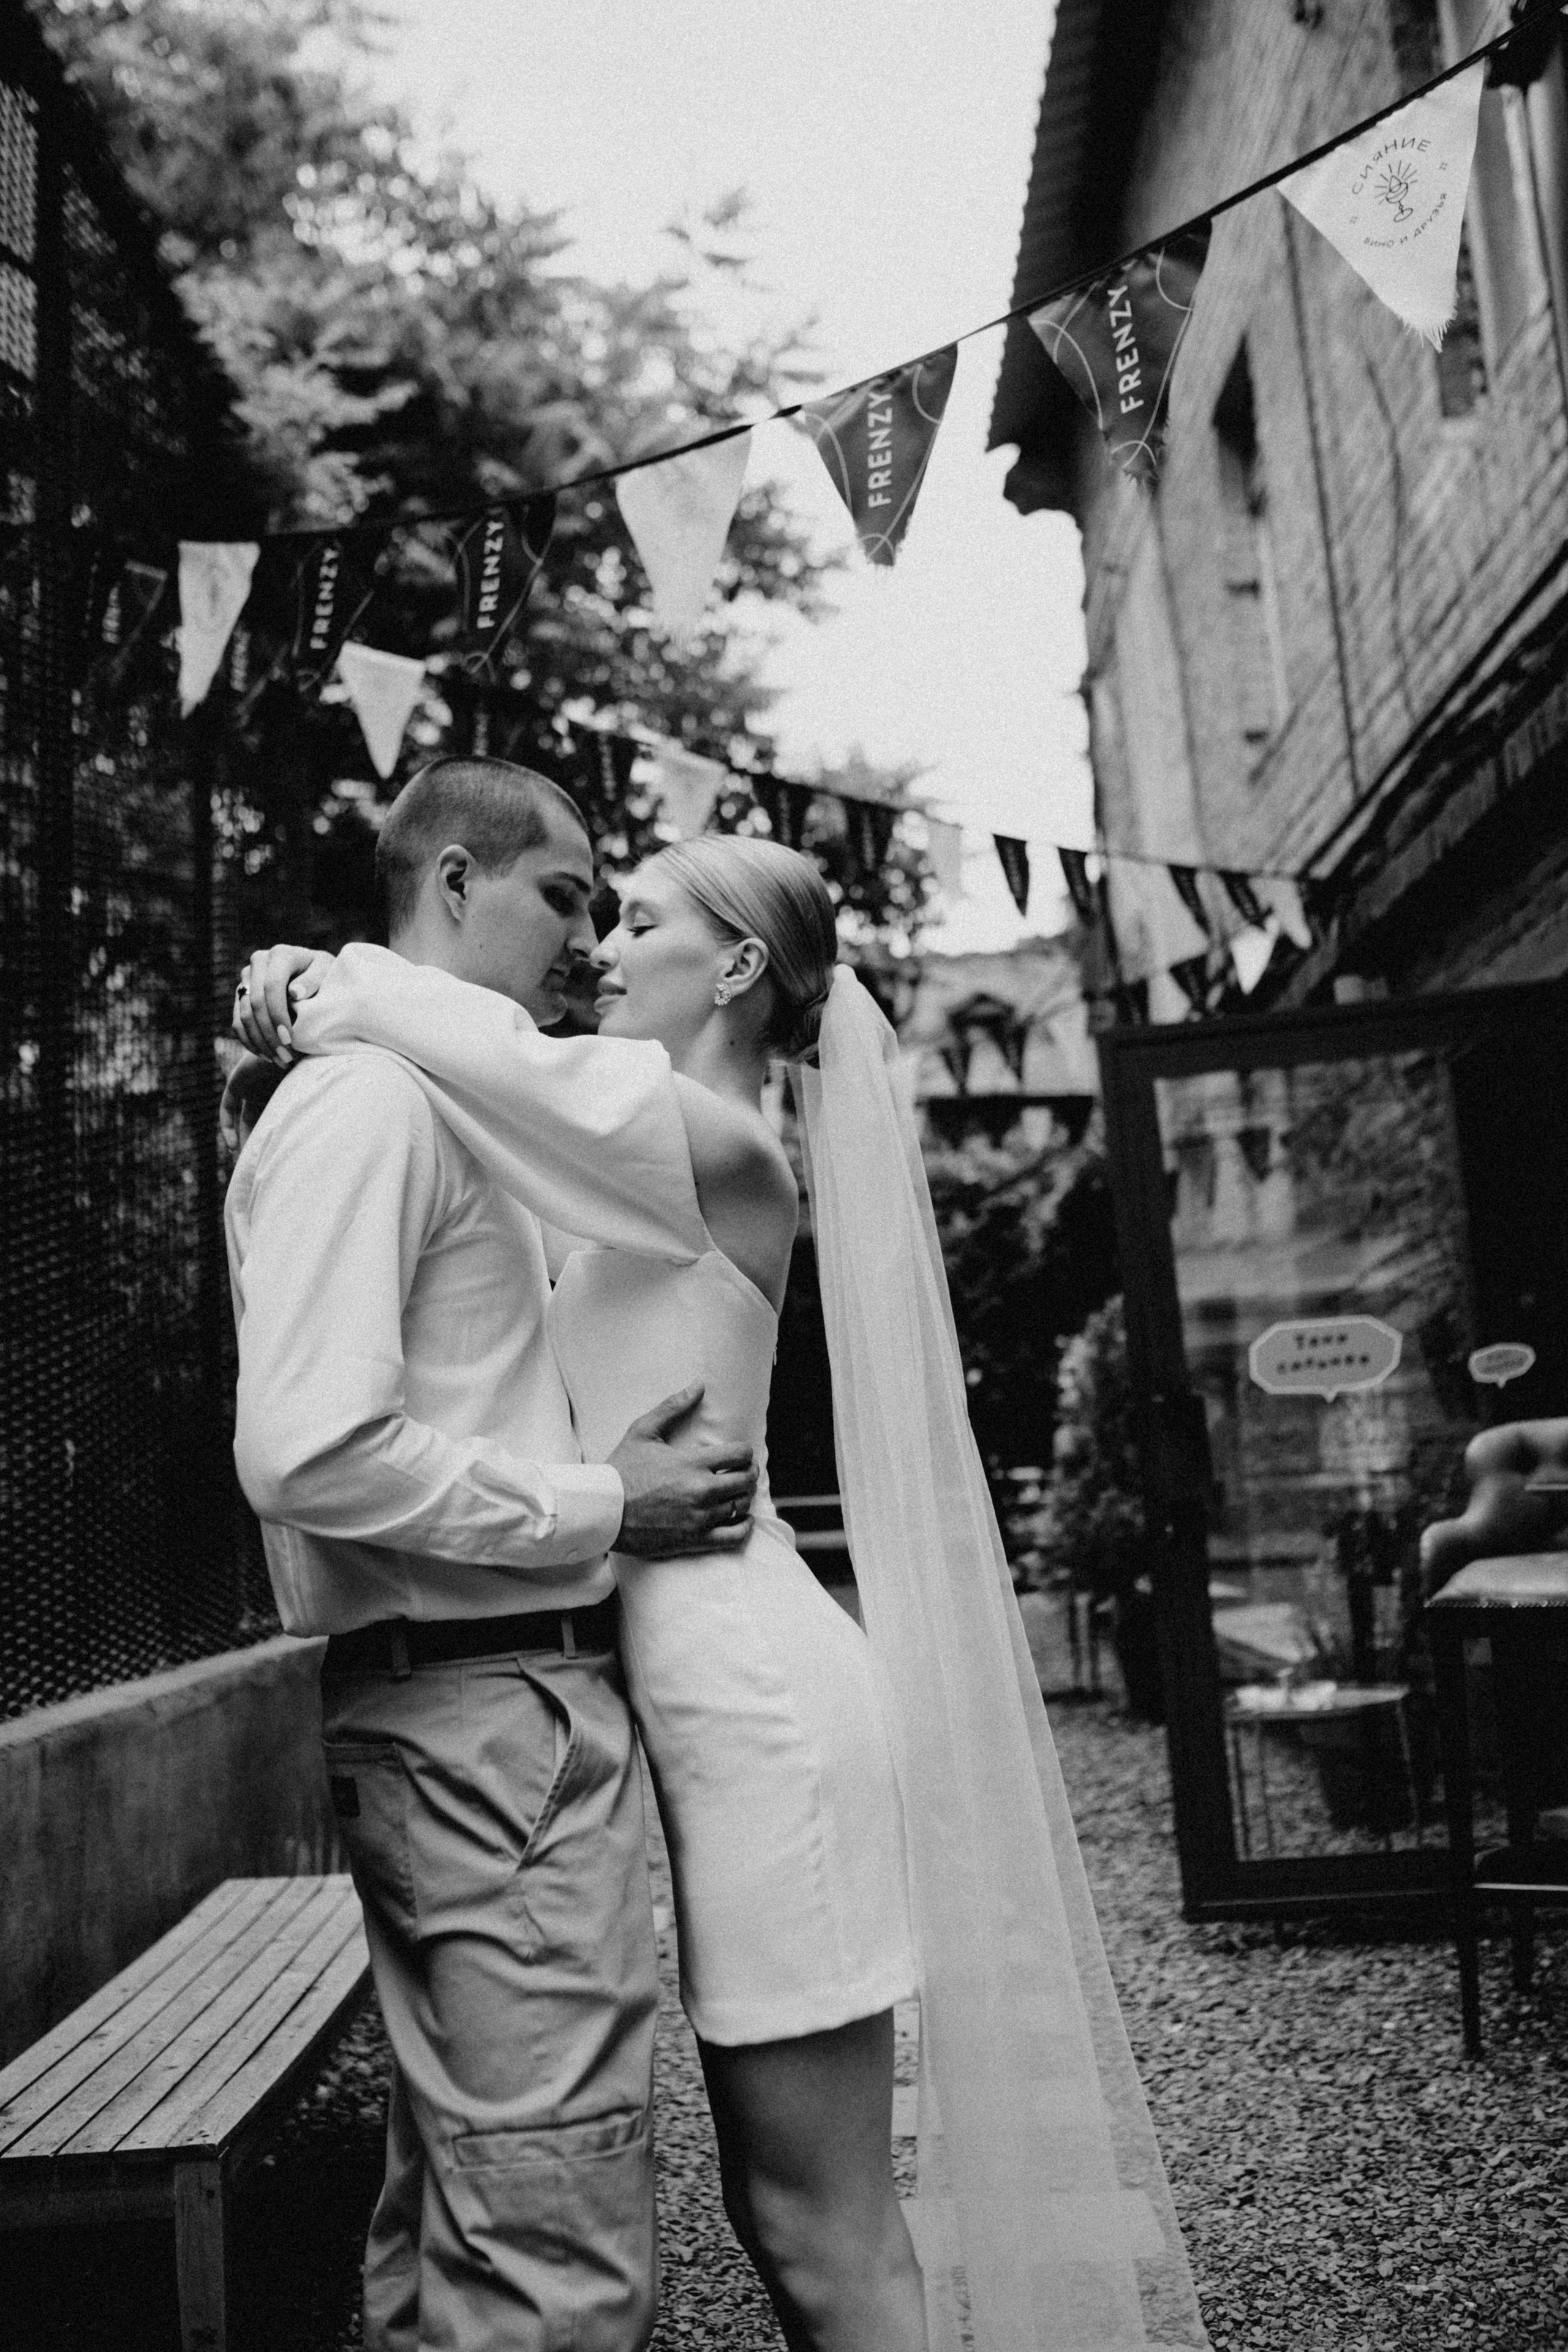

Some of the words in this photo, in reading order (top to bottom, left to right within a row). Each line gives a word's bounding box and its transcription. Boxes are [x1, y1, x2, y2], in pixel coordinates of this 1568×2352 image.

[1352, 137, 1431, 195] СИЯНИЕ
[1414, 193, 1447, 238] ДРУЗЬЯ
[1107, 285, 1145, 414] FRENZY
[867, 391, 892, 508] FRENZY
[310, 548, 340, 650] FRENZY
[477, 521, 505, 629] FRENZY
